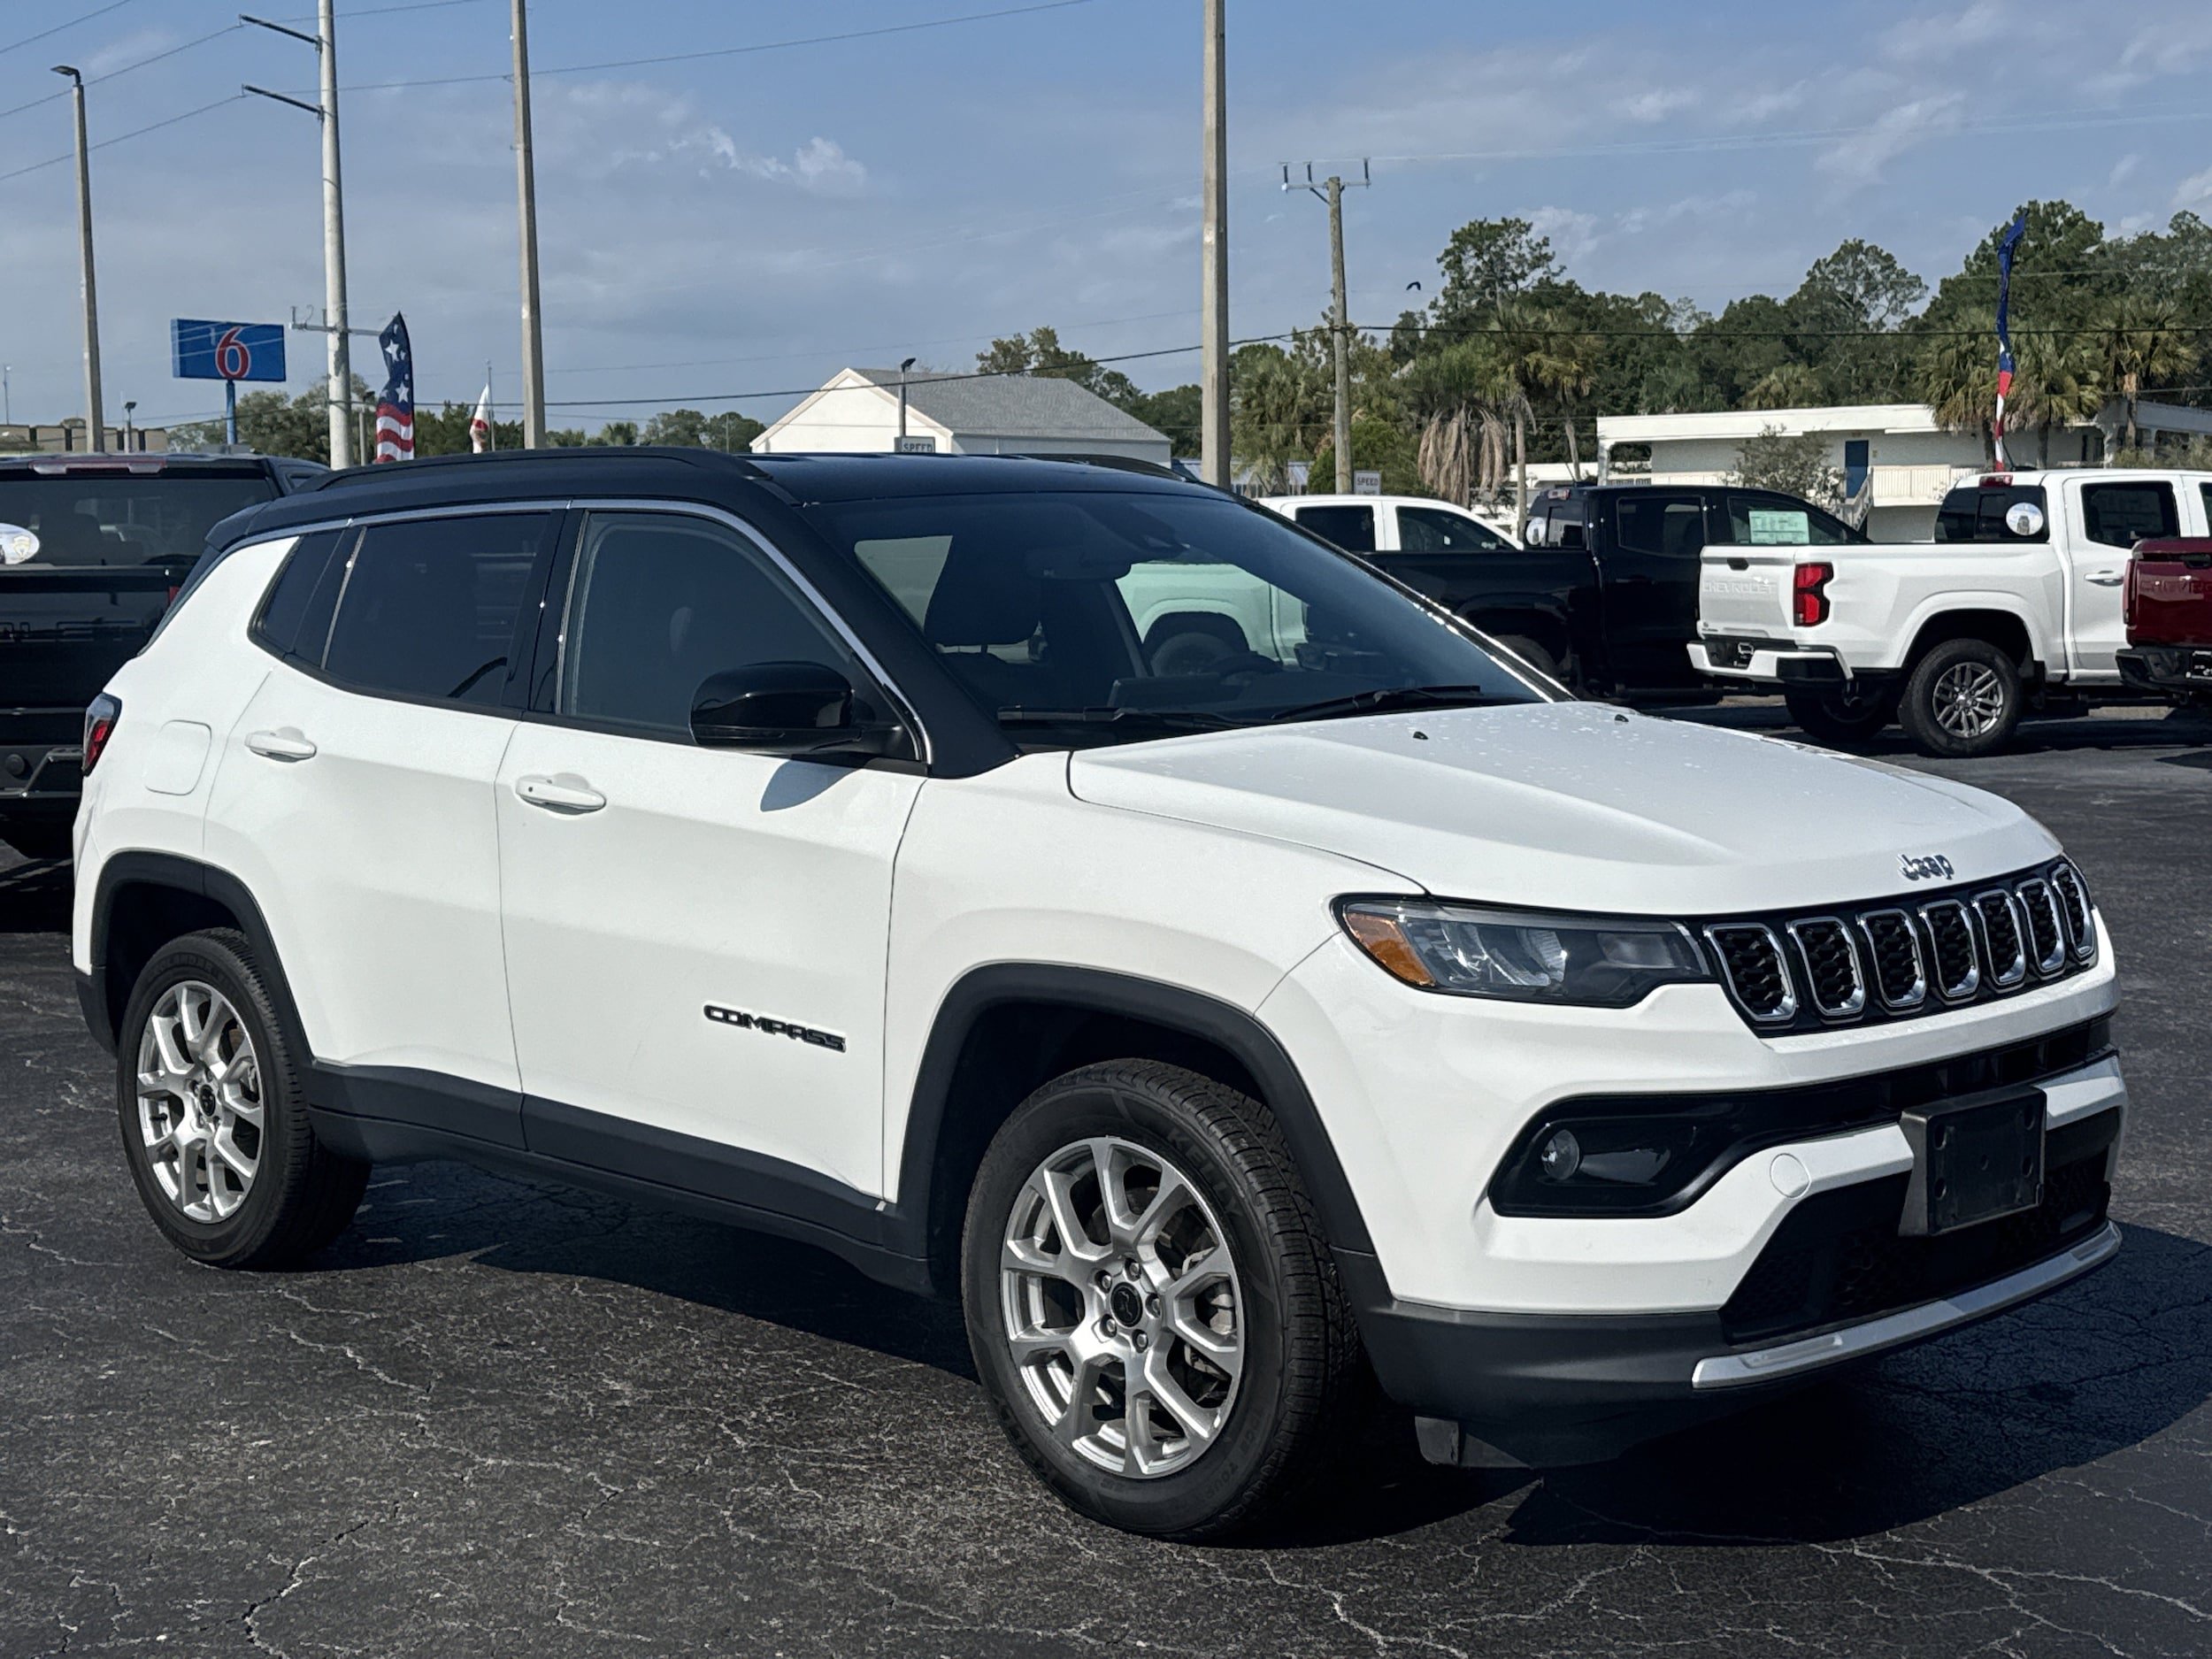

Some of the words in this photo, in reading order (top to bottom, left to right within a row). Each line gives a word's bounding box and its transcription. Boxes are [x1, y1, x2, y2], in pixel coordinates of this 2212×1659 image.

[215, 326, 251, 379] 6
[902, 443, 933, 453] SPEED
[1356, 477, 1379, 487] SPEED
[1702, 580, 1777, 595] CHEVROLET
[1897, 854, 1955, 881] Jeep
[703, 1004, 847, 1053] COMPASS
